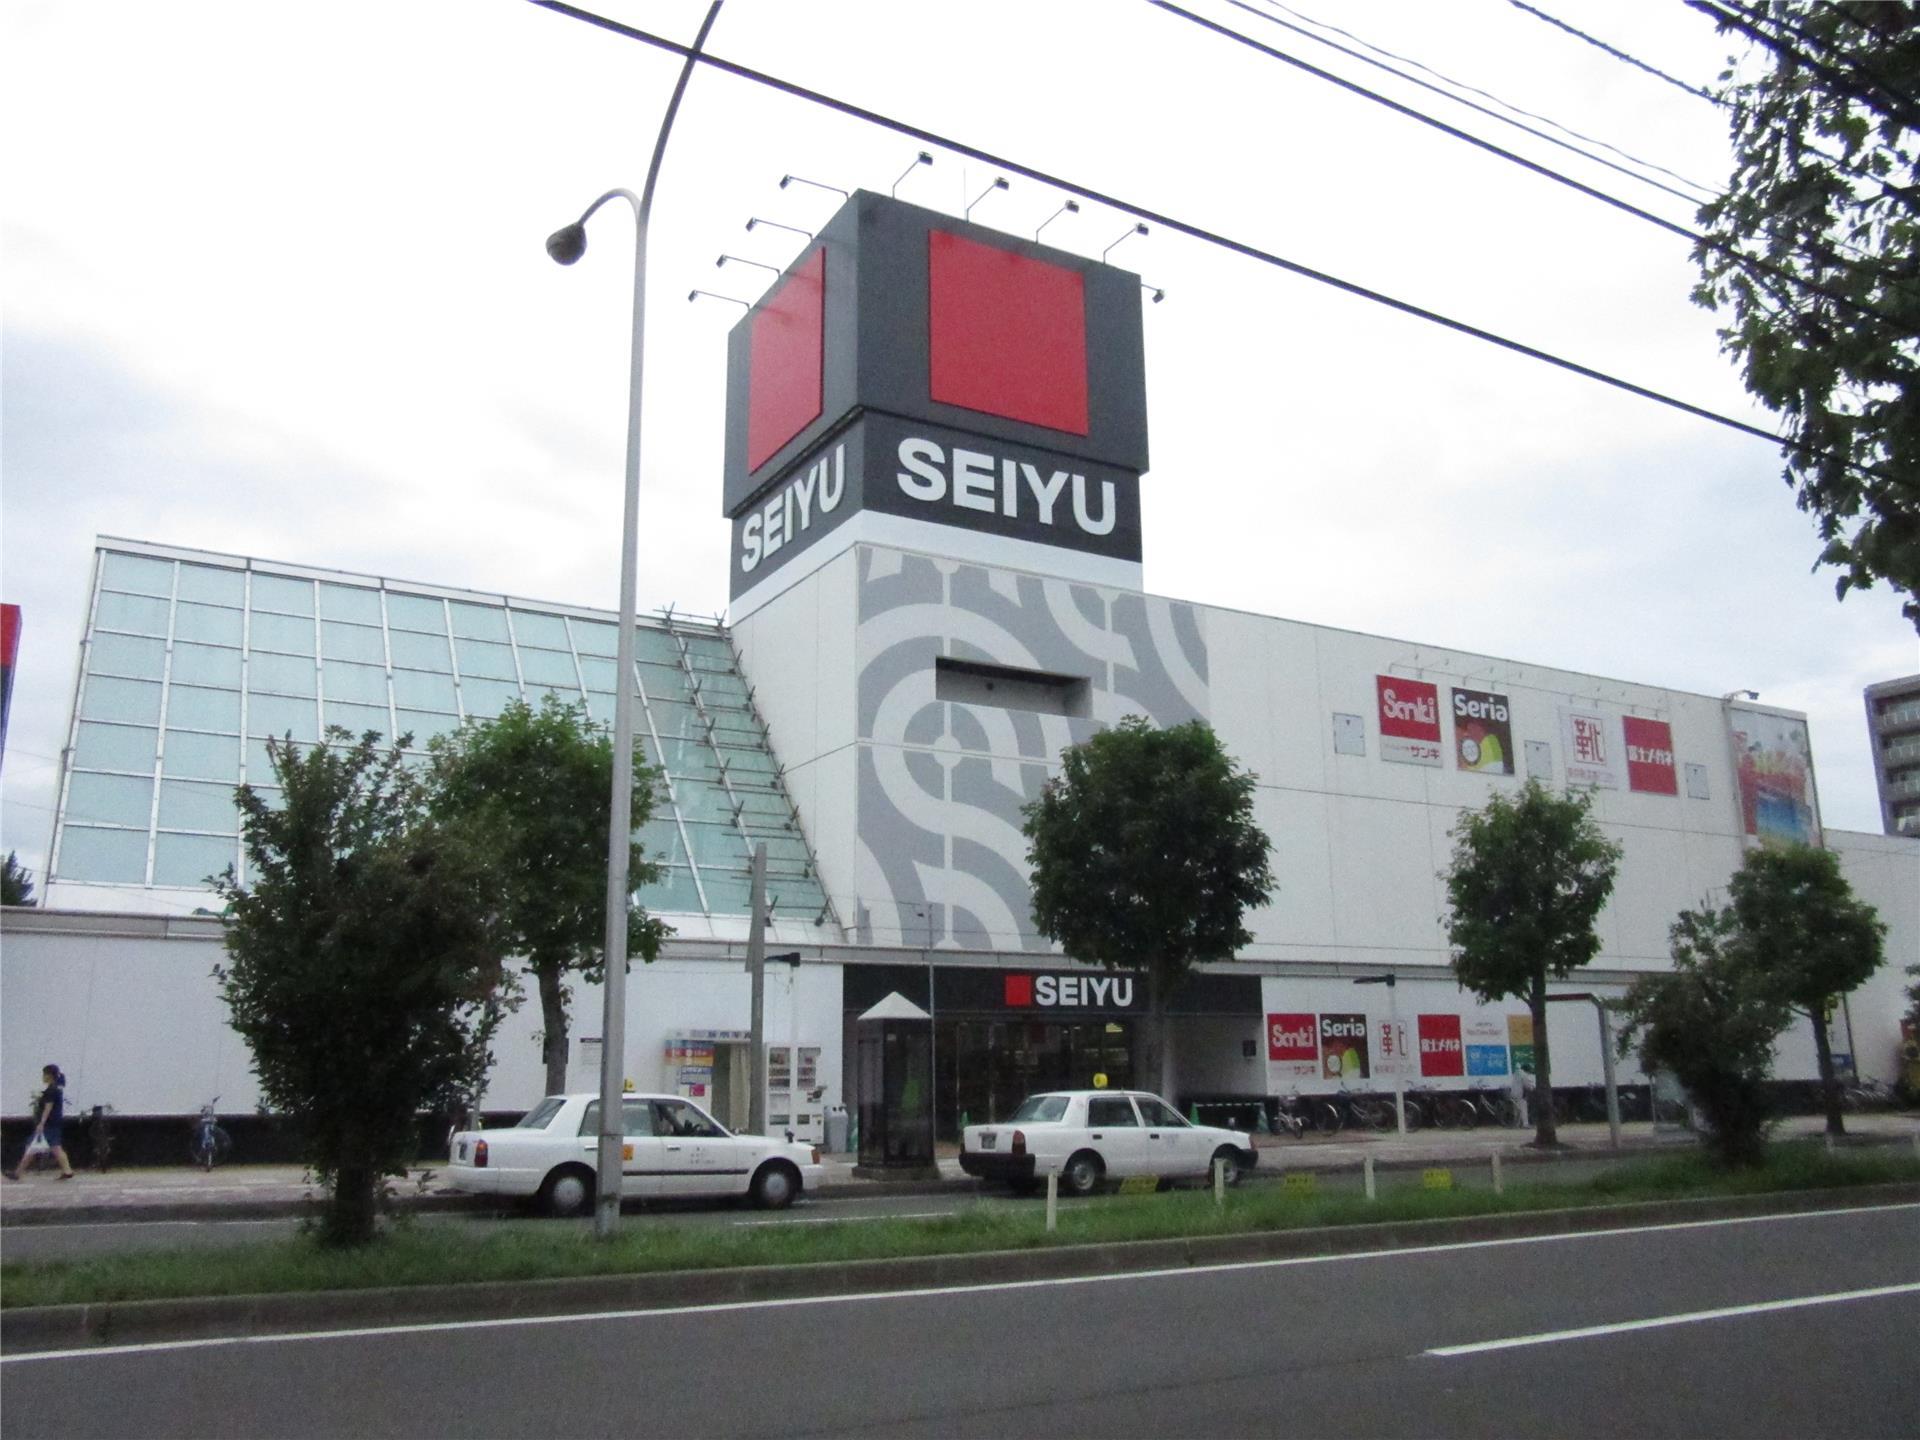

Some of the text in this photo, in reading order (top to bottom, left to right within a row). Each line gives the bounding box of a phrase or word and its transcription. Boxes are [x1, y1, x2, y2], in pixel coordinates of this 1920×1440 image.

[896, 437, 1116, 537] SEIYU
[740, 444, 846, 573] SEIYU
[1454, 694, 1508, 722] Seria
[1035, 975, 1133, 1007] SEIYU
[1322, 1018, 1366, 1037] Seria
